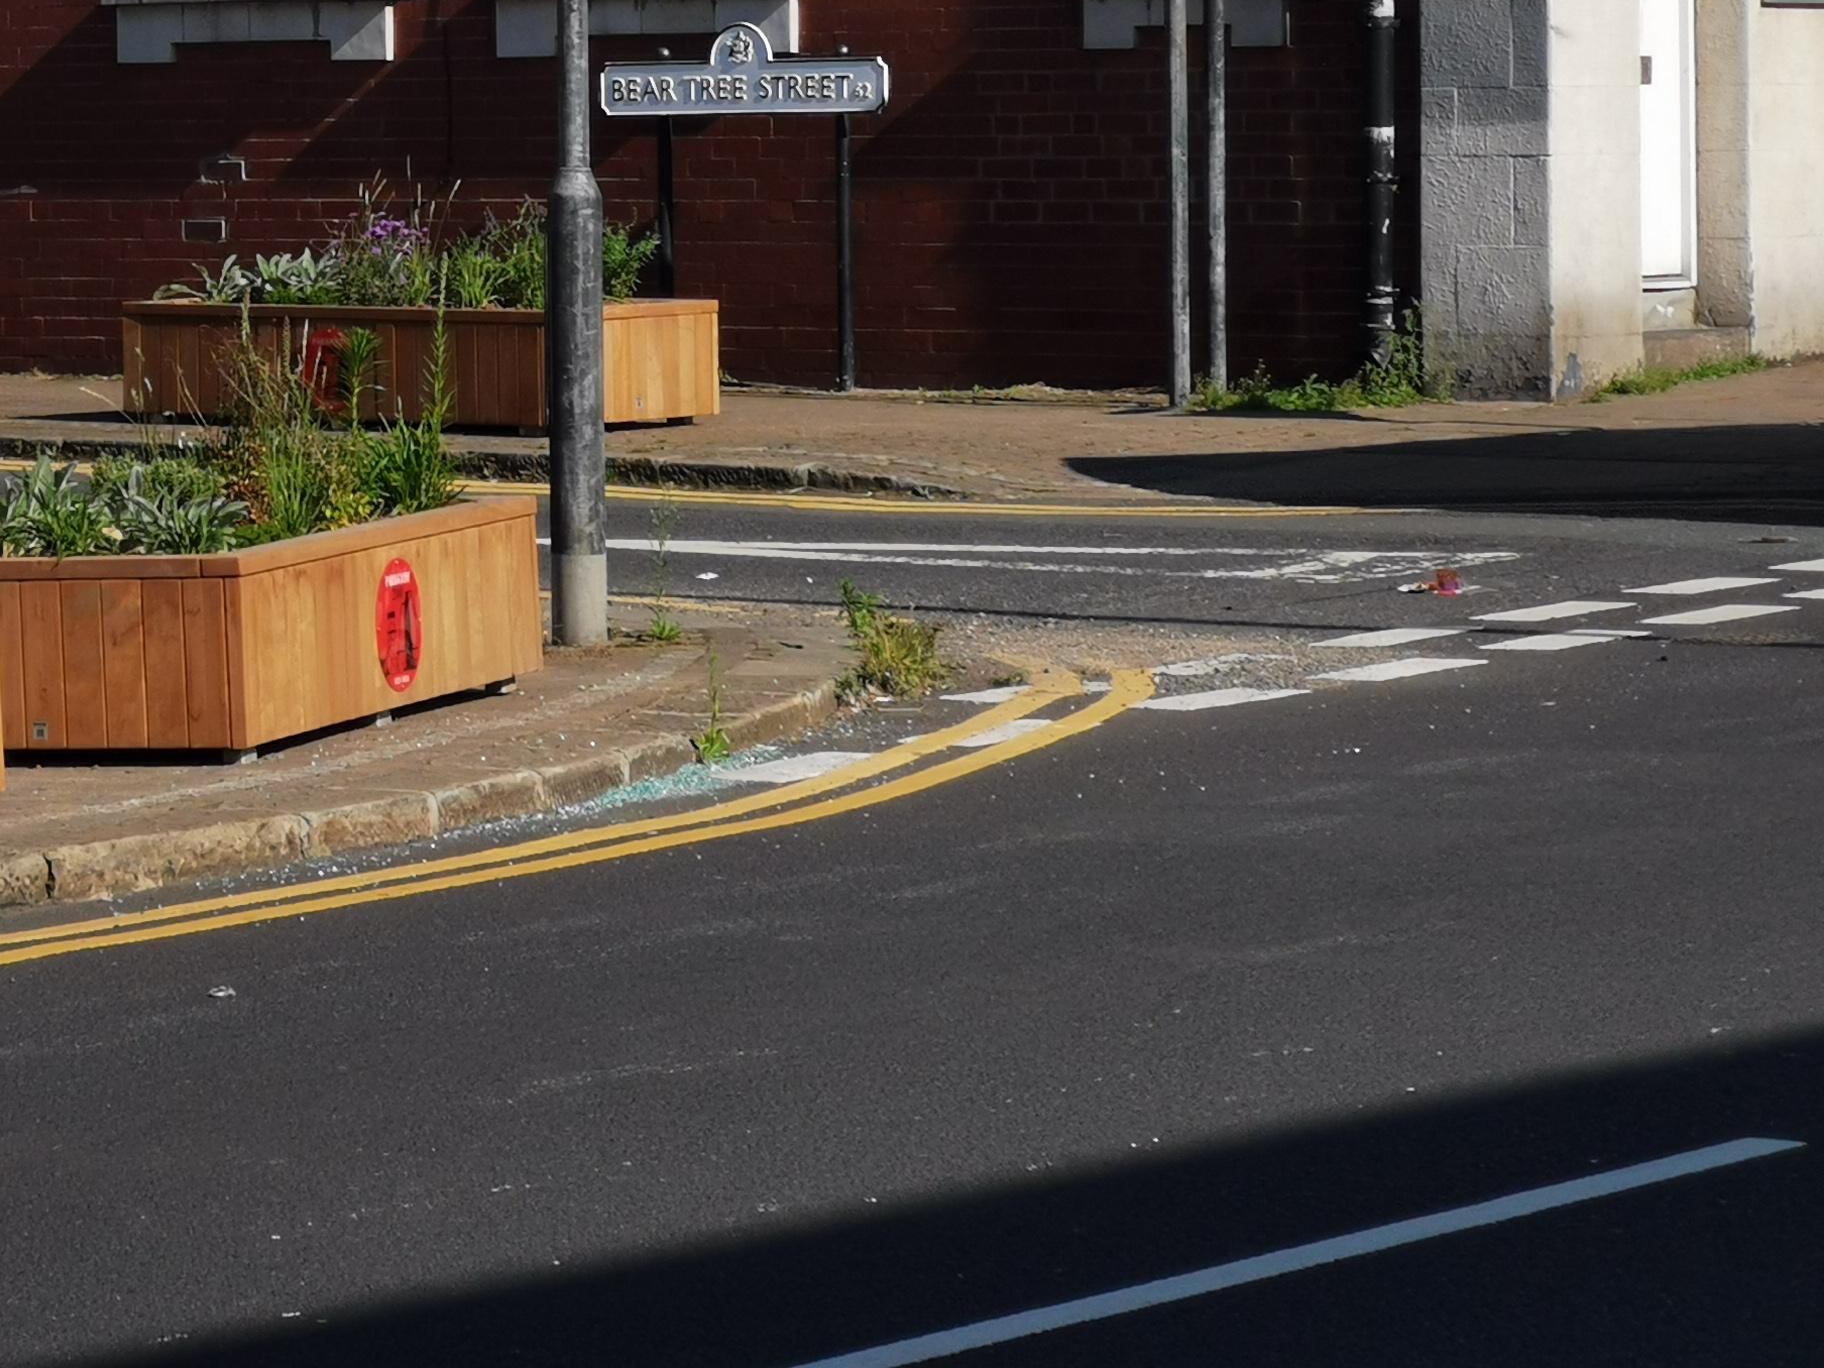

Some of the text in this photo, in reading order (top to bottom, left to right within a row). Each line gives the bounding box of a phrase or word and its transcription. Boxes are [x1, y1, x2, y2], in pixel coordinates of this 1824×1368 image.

[611, 76, 678, 102] BEAR
[683, 75, 748, 101] TREE
[758, 73, 854, 101] STREET
